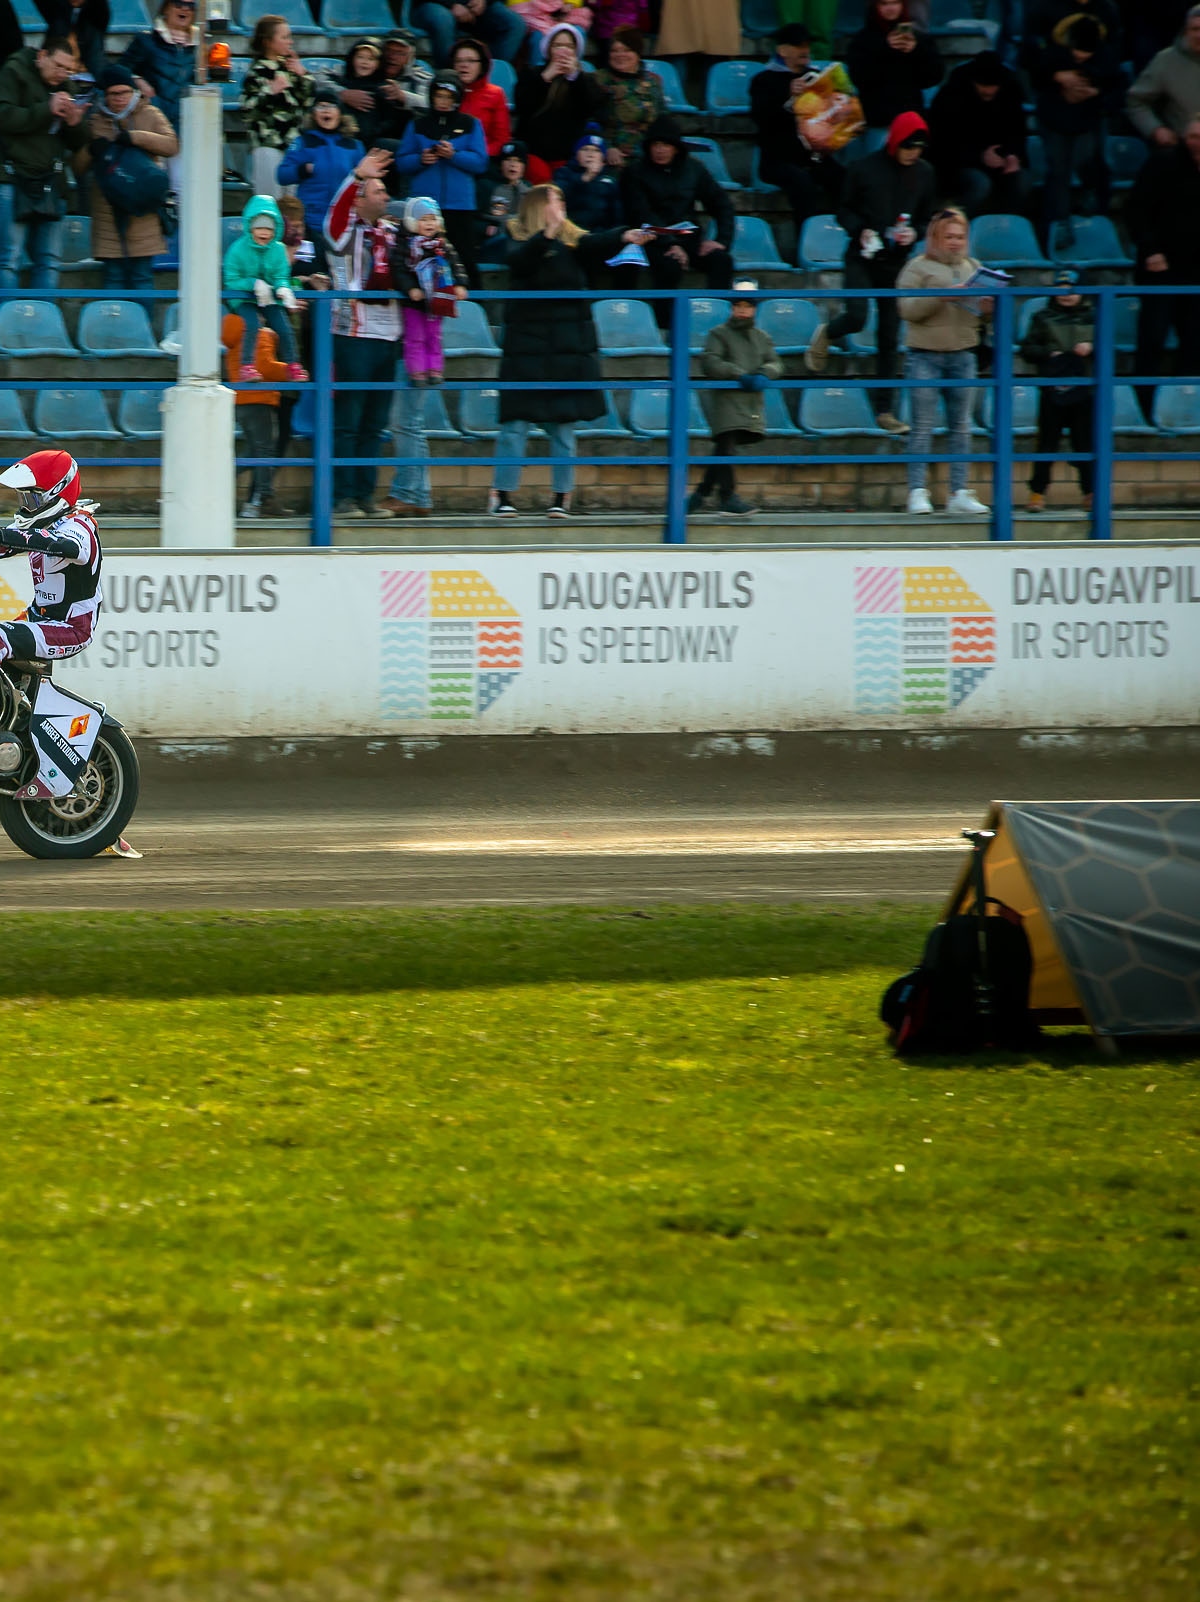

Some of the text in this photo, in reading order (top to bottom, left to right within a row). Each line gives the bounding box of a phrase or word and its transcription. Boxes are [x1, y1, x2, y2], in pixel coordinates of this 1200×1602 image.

[100, 574, 279, 613] UGAVPILS
[537, 570, 755, 610] DAUGAVPILS
[1010, 566, 1200, 605] DAUGAVPIL
[100, 629, 220, 668] SPORTS
[538, 625, 739, 664] IS SPEEDWAY
[1011, 620, 1169, 659] IR SPORTS
[39, 719, 80, 766] AMBER STUDIOS
